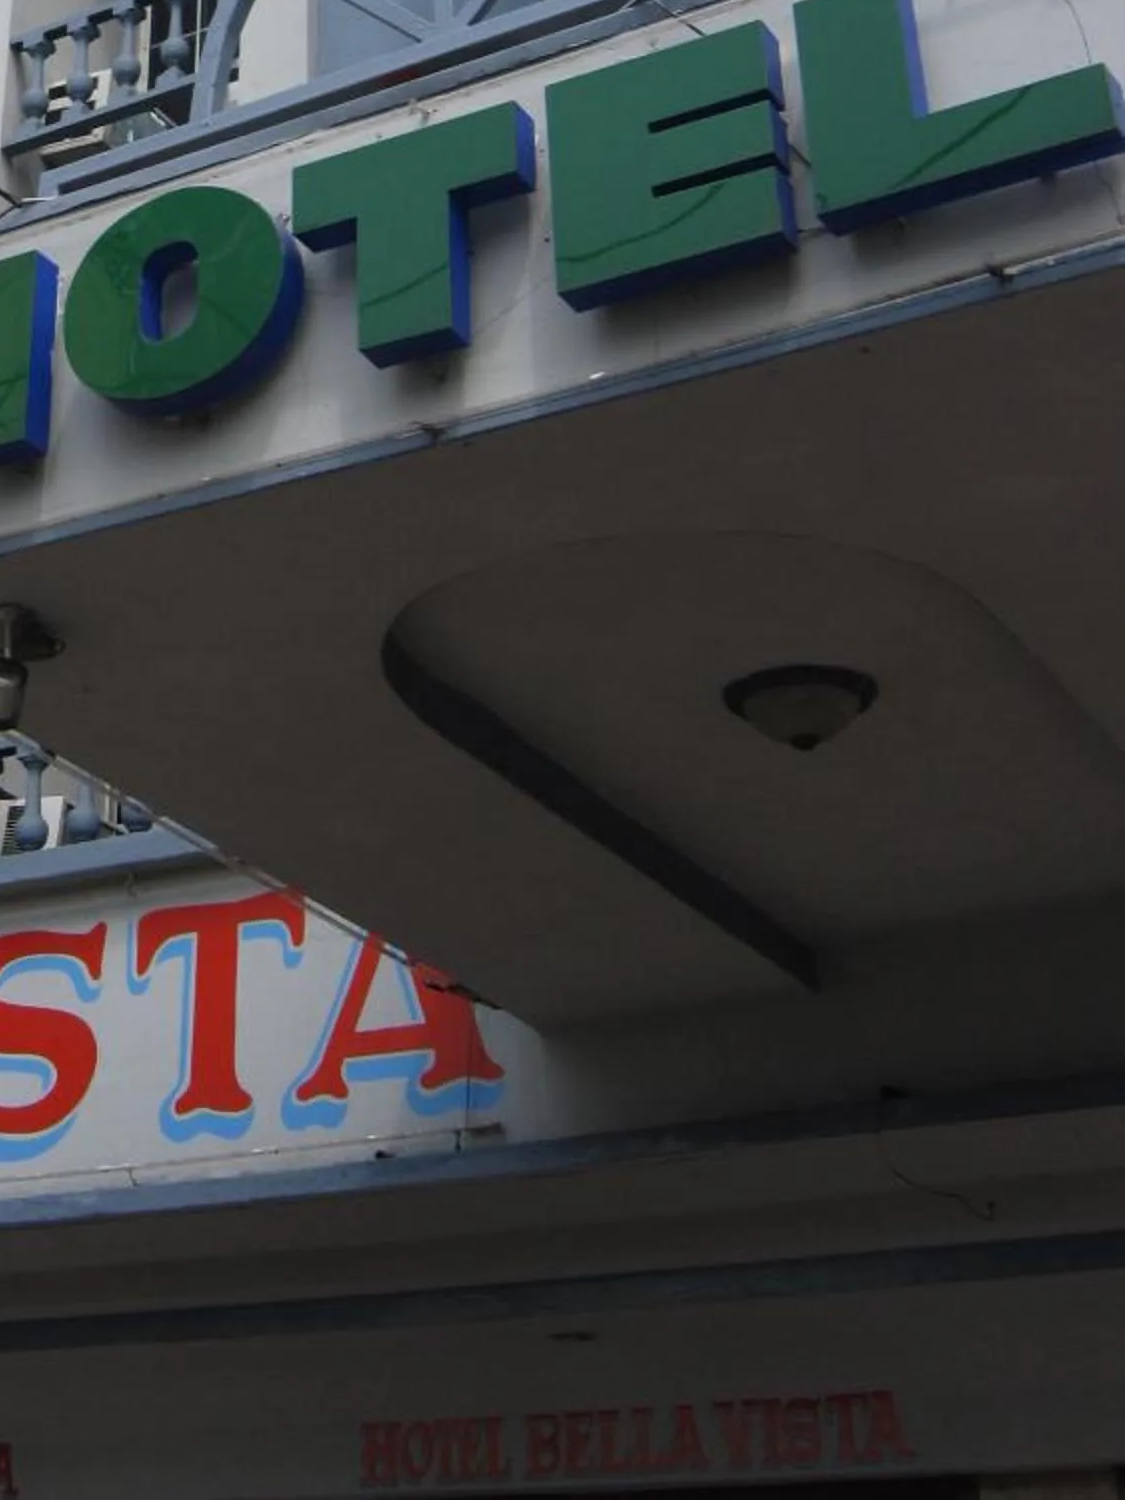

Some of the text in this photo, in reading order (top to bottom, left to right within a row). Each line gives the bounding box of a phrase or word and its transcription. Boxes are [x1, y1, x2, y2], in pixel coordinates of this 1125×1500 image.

[359, 1388, 916, 1485] HOTEL BELLA VISTA
